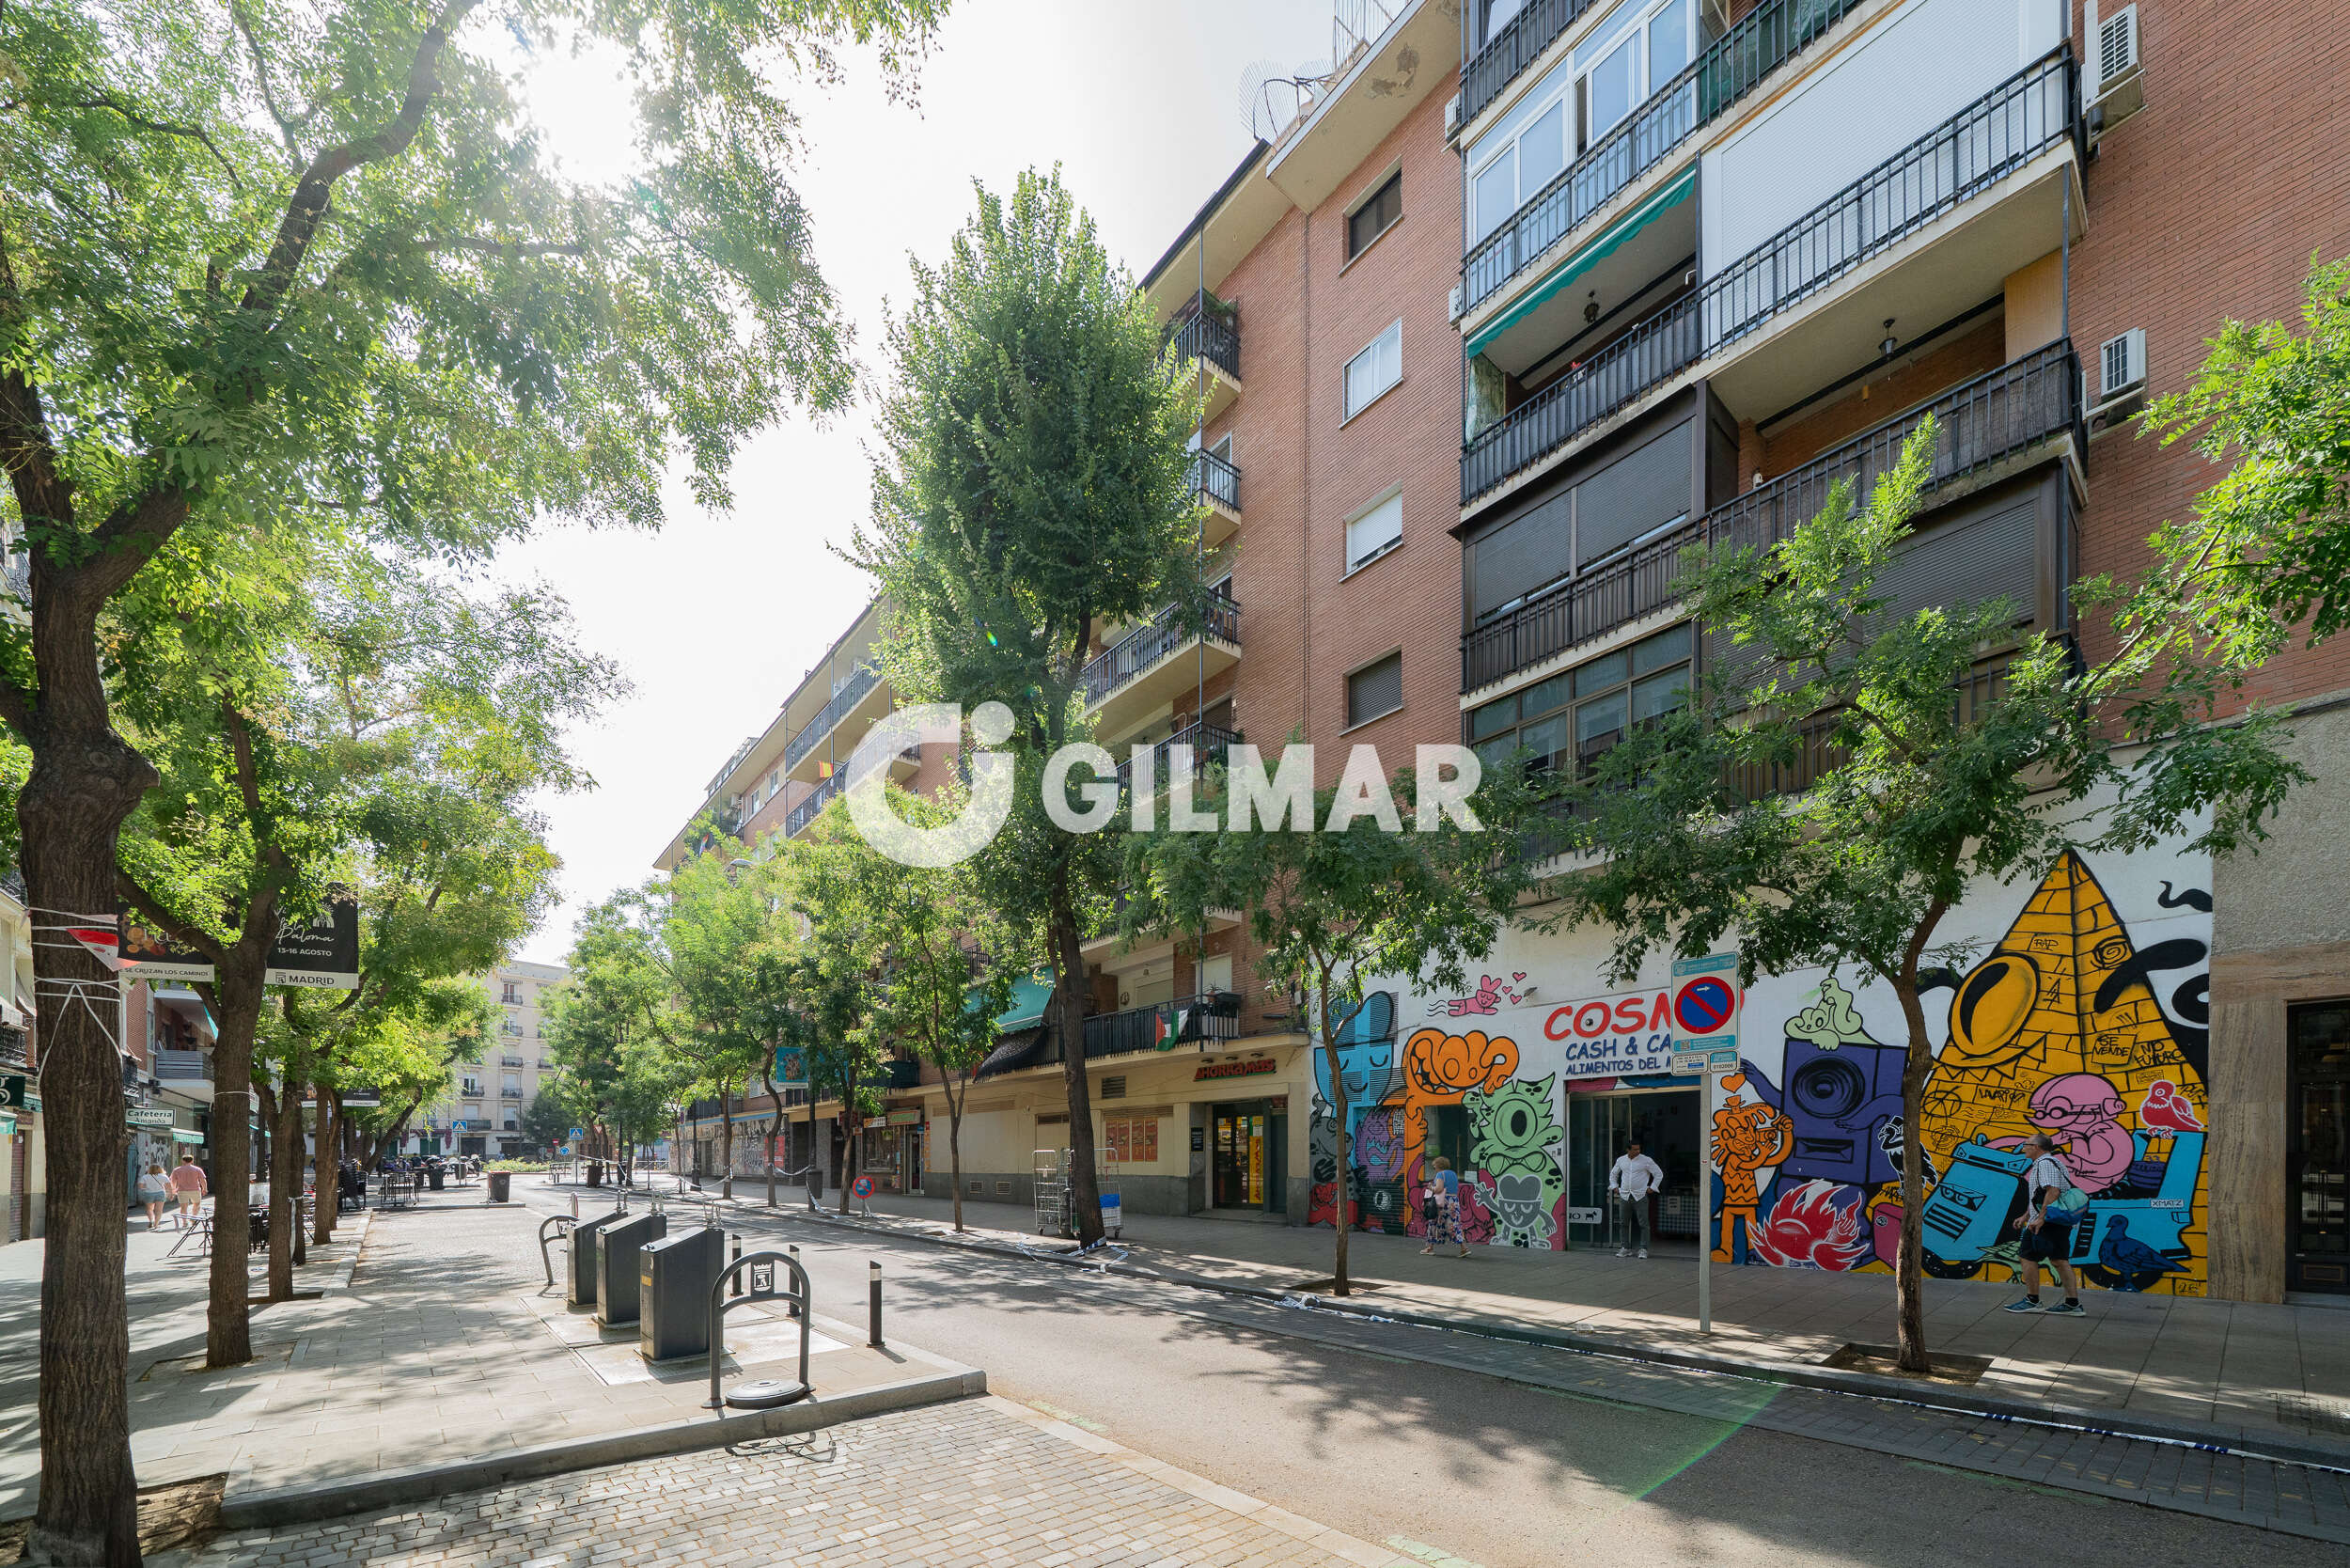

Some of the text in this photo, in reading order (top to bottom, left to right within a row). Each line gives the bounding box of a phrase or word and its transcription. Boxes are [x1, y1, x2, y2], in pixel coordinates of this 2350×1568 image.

[289, 975, 335, 986] MADRID
[1565, 1037, 1617, 1060] CASH
[1624, 1036, 1638, 1055] &
[2094, 1046, 2131, 1057] VENDE
[2139, 1040, 2165, 1055] NO
[1565, 1059, 1634, 1075] ALIMENTOS
[1638, 1055, 1661, 1070] DEL
